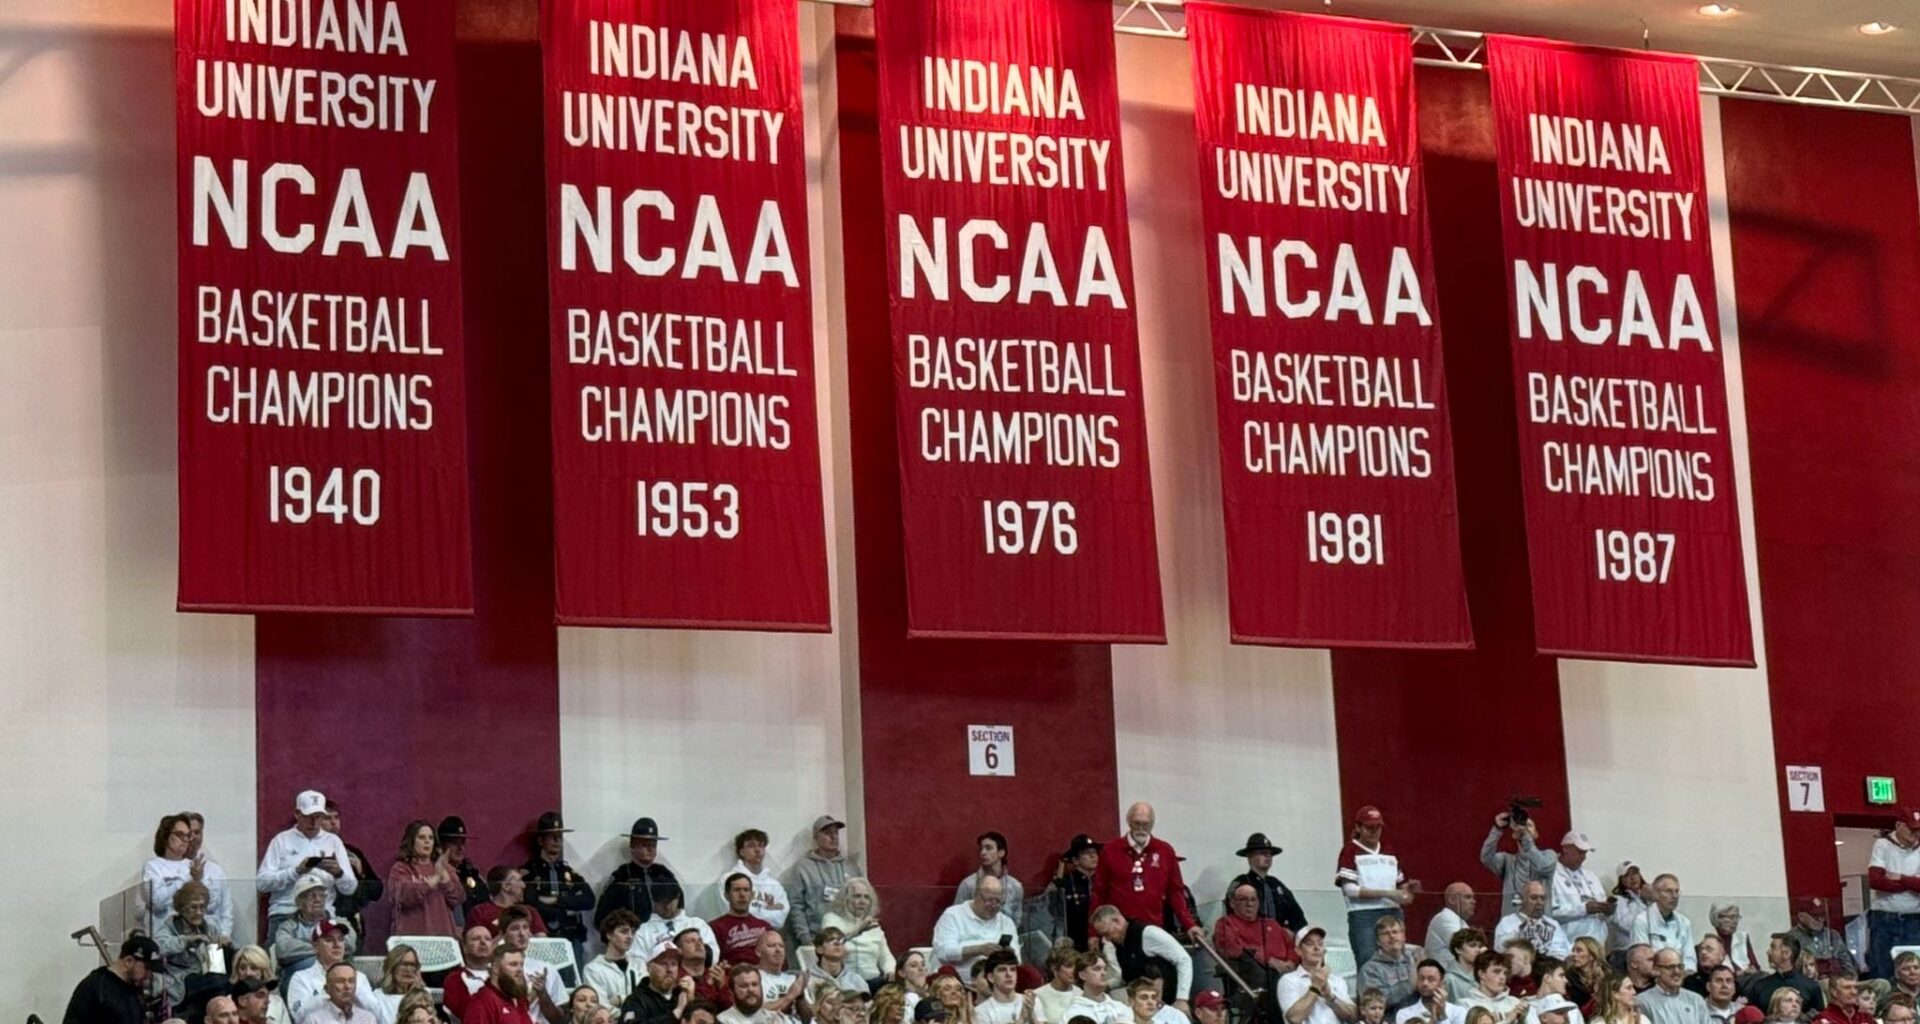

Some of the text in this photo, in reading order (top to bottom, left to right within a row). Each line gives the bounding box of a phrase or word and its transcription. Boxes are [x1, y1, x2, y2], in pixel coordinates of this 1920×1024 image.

[225, 0, 409, 56] INDIANA
[589, 20, 758, 90] INDIANA
[196, 59, 436, 133] UNIVERSITY
[924, 55, 1086, 121] INDIANA
[1234, 82, 1387, 147] INDIANA
[563, 91, 784, 165] UNIVERSITY
[900, 125, 1111, 191] UNIVERSITY
[1529, 113, 1672, 175] INDIANA
[192, 155, 450, 261] NCAA
[1216, 147, 1411, 215] UNIVERSITY
[1512, 176, 1694, 241] UNIVERSITY
[560, 183, 800, 288] NCAA
[898, 213, 1128, 310] NCAA
[1218, 232, 1433, 327] NCAA
[1514, 259, 1714, 352] NCAA
[198, 285, 444, 355] BASKETBALL
[567, 308, 798, 377] BASKETBALL
[908, 334, 1126, 397] BASKETBALL
[1231, 348, 1436, 410] BASKETBALL
[206, 365, 433, 431] CHAMPIONS
[581, 385, 791, 450] CHAMPIONS
[1528, 372, 1717, 434] BASKETBALL
[921, 407, 1120, 468] CHAMPIONS
[1243, 420, 1432, 478] CHAMPIONS
[270, 465, 381, 526] 1940
[1543, 441, 1715, 502] CHAMPIONS
[637, 480, 739, 539] 1953
[983, 500, 1078, 555] 1976
[1307, 510, 1384, 565] 1981
[1595, 528, 1676, 584] 1987
[971, 730, 1011, 742] SECTION
[985, 743, 999, 769] 6
[1789, 770, 1819, 781] SECTION
[1800, 782, 1810, 806] 7
